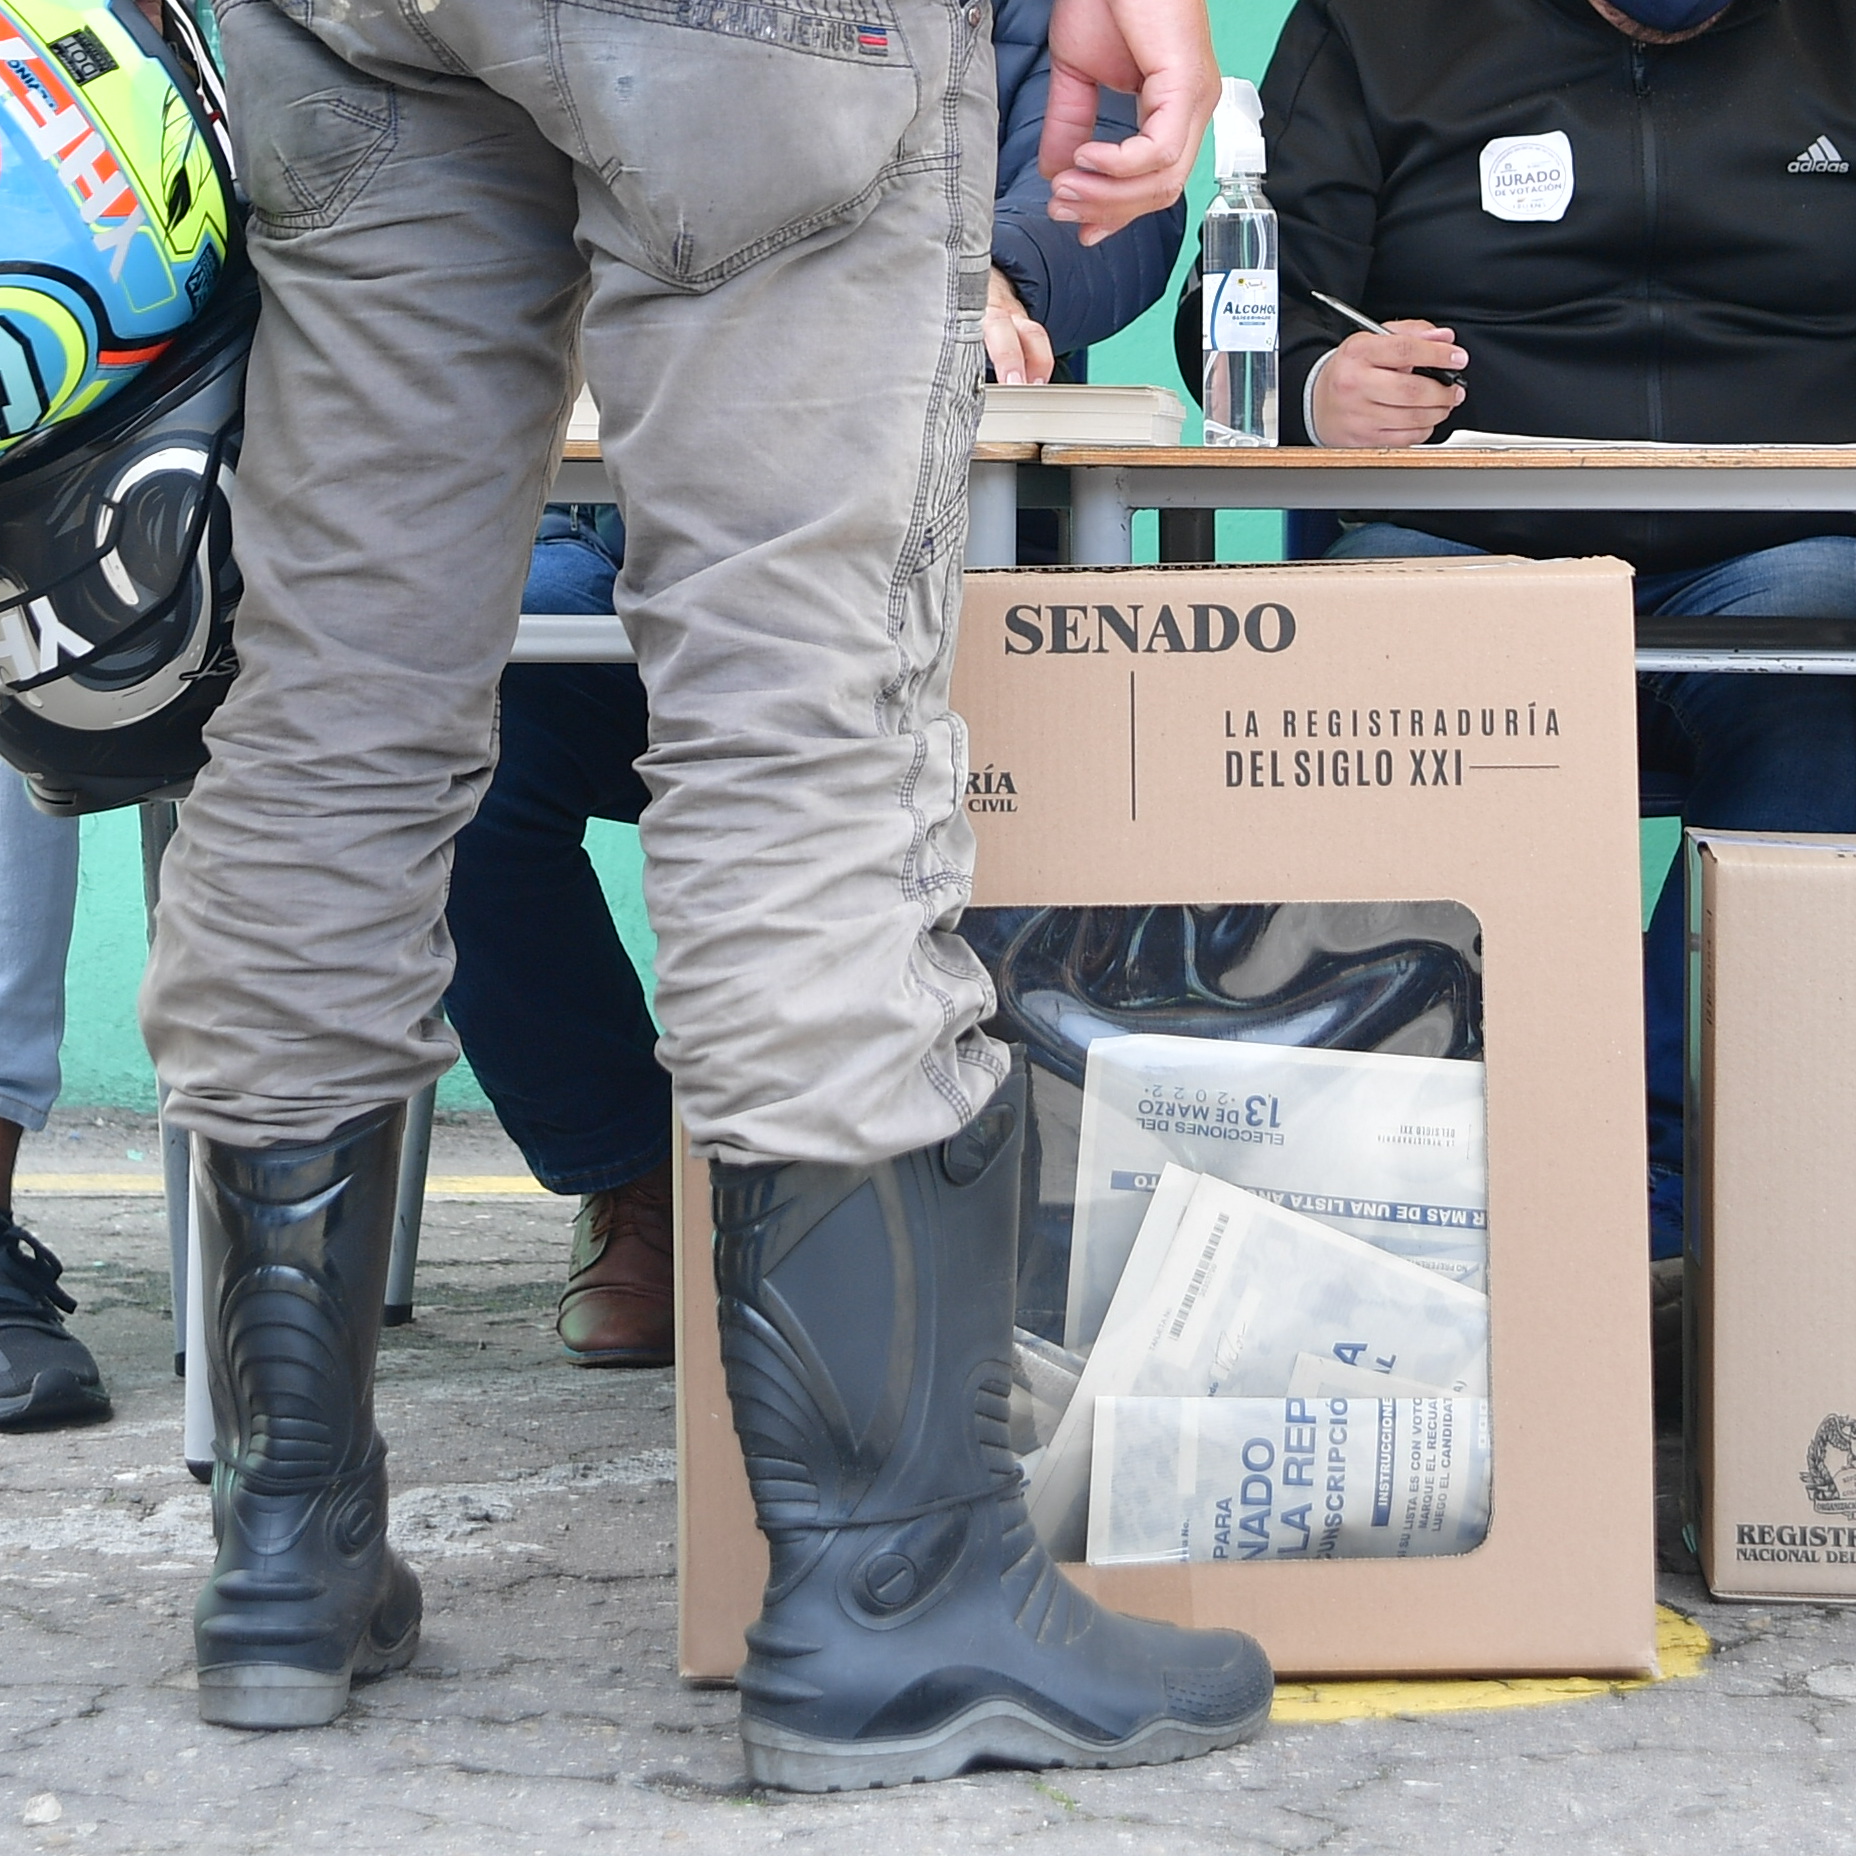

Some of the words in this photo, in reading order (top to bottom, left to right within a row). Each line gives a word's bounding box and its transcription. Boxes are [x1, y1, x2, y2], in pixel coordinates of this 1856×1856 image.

[57, 36, 98, 78] DOT
[1787, 156, 1850, 174] adidas
[1495, 169, 1561, 188] JURADO
[1494, 189, 1506, 197] DE
[1509, 182, 1562, 196] VOTACIÓN
[1222, 301, 1276, 315] ALCOHOL
[1003, 601, 1298, 656] SENADO
[1225, 710, 1260, 739] LA
[1283, 702, 1563, 739] REGISTRADURÍA
[1225, 750, 1286, 788] DEL
[1293, 750, 1394, 788] SIGLO
[1409, 748, 1464, 787] XXI
[968, 798, 1018, 814] CIVIL
[1138, 1099, 1210, 1122] MARZO
[1215, 1107, 1240, 1125] DE
[1245, 1094, 1282, 1128] 13
[1136, 1116, 1170, 1132] DEL
[1174, 1120, 1285, 1146] ELECCIONES
[1290, 1194, 1344, 1214] LISTA
[1350, 1200, 1391, 1219] UNA
[1396, 1205, 1421, 1221] DE
[1427, 1208, 1467, 1228] MÁS
[1282, 1397, 1317, 1487] REP
[1377, 1397, 1393, 1506] INSTRUCCIONE
[1411, 1439, 1421, 1471] CON
[1426, 1454, 1436, 1472] EL
[1409, 1476, 1420, 1493] ES
[1418, 1475, 1435, 1530] MARQUE
[1431, 1493, 1447, 1532] LUEGO
[1439, 1472, 1450, 1490] EL
[1403, 1496, 1418, 1531] LISTA
[1213, 1496, 1233, 1560] PARA
[1277, 1502, 1313, 1554] LA
[1399, 1533, 1411, 1548] SU
[1735, 1547, 1820, 1563] NACIONAL
